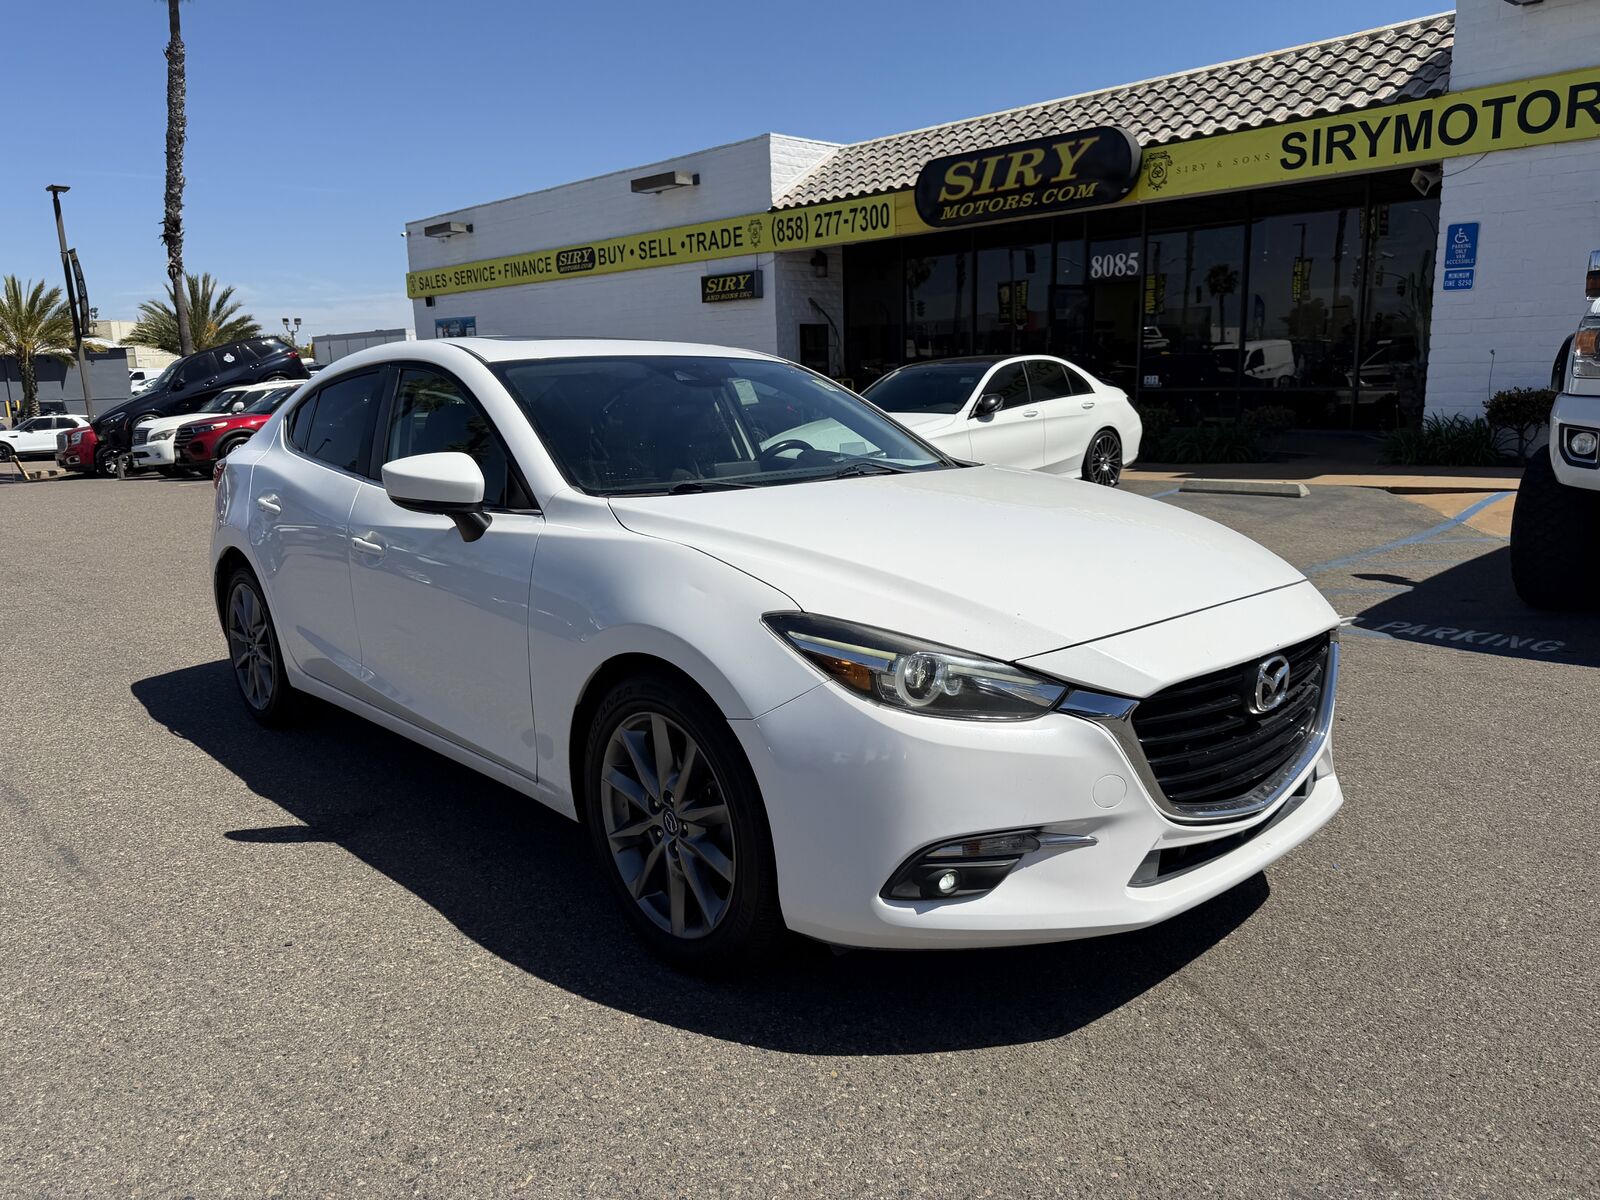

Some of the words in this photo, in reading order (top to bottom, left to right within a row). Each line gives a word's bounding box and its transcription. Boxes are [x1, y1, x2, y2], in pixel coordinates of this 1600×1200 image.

[937, 136, 1100, 203] SIRY
[1176, 162, 1207, 175] SIRY
[1216, 160, 1224, 169] &
[1232, 152, 1271, 166] SONS
[940, 182, 1099, 220] MOTORS.COM
[771, 212, 809, 247] (858)
[814, 203, 890, 238] 277-7300
[559, 249, 592, 266] SIRY
[600, 244, 626, 266] BUY
[638, 237, 677, 260] SELL
[686, 226, 743, 254] TRADE
[418, 274, 447, 291] SALES
[454, 266, 496, 286] SERVICE
[504, 257, 552, 279] FINANCE
[1090, 252, 1139, 279] 8085
[705, 274, 751, 294] SIRY
[720, 292, 739, 300] SONS
[1373, 621, 1566, 652] PARKING
